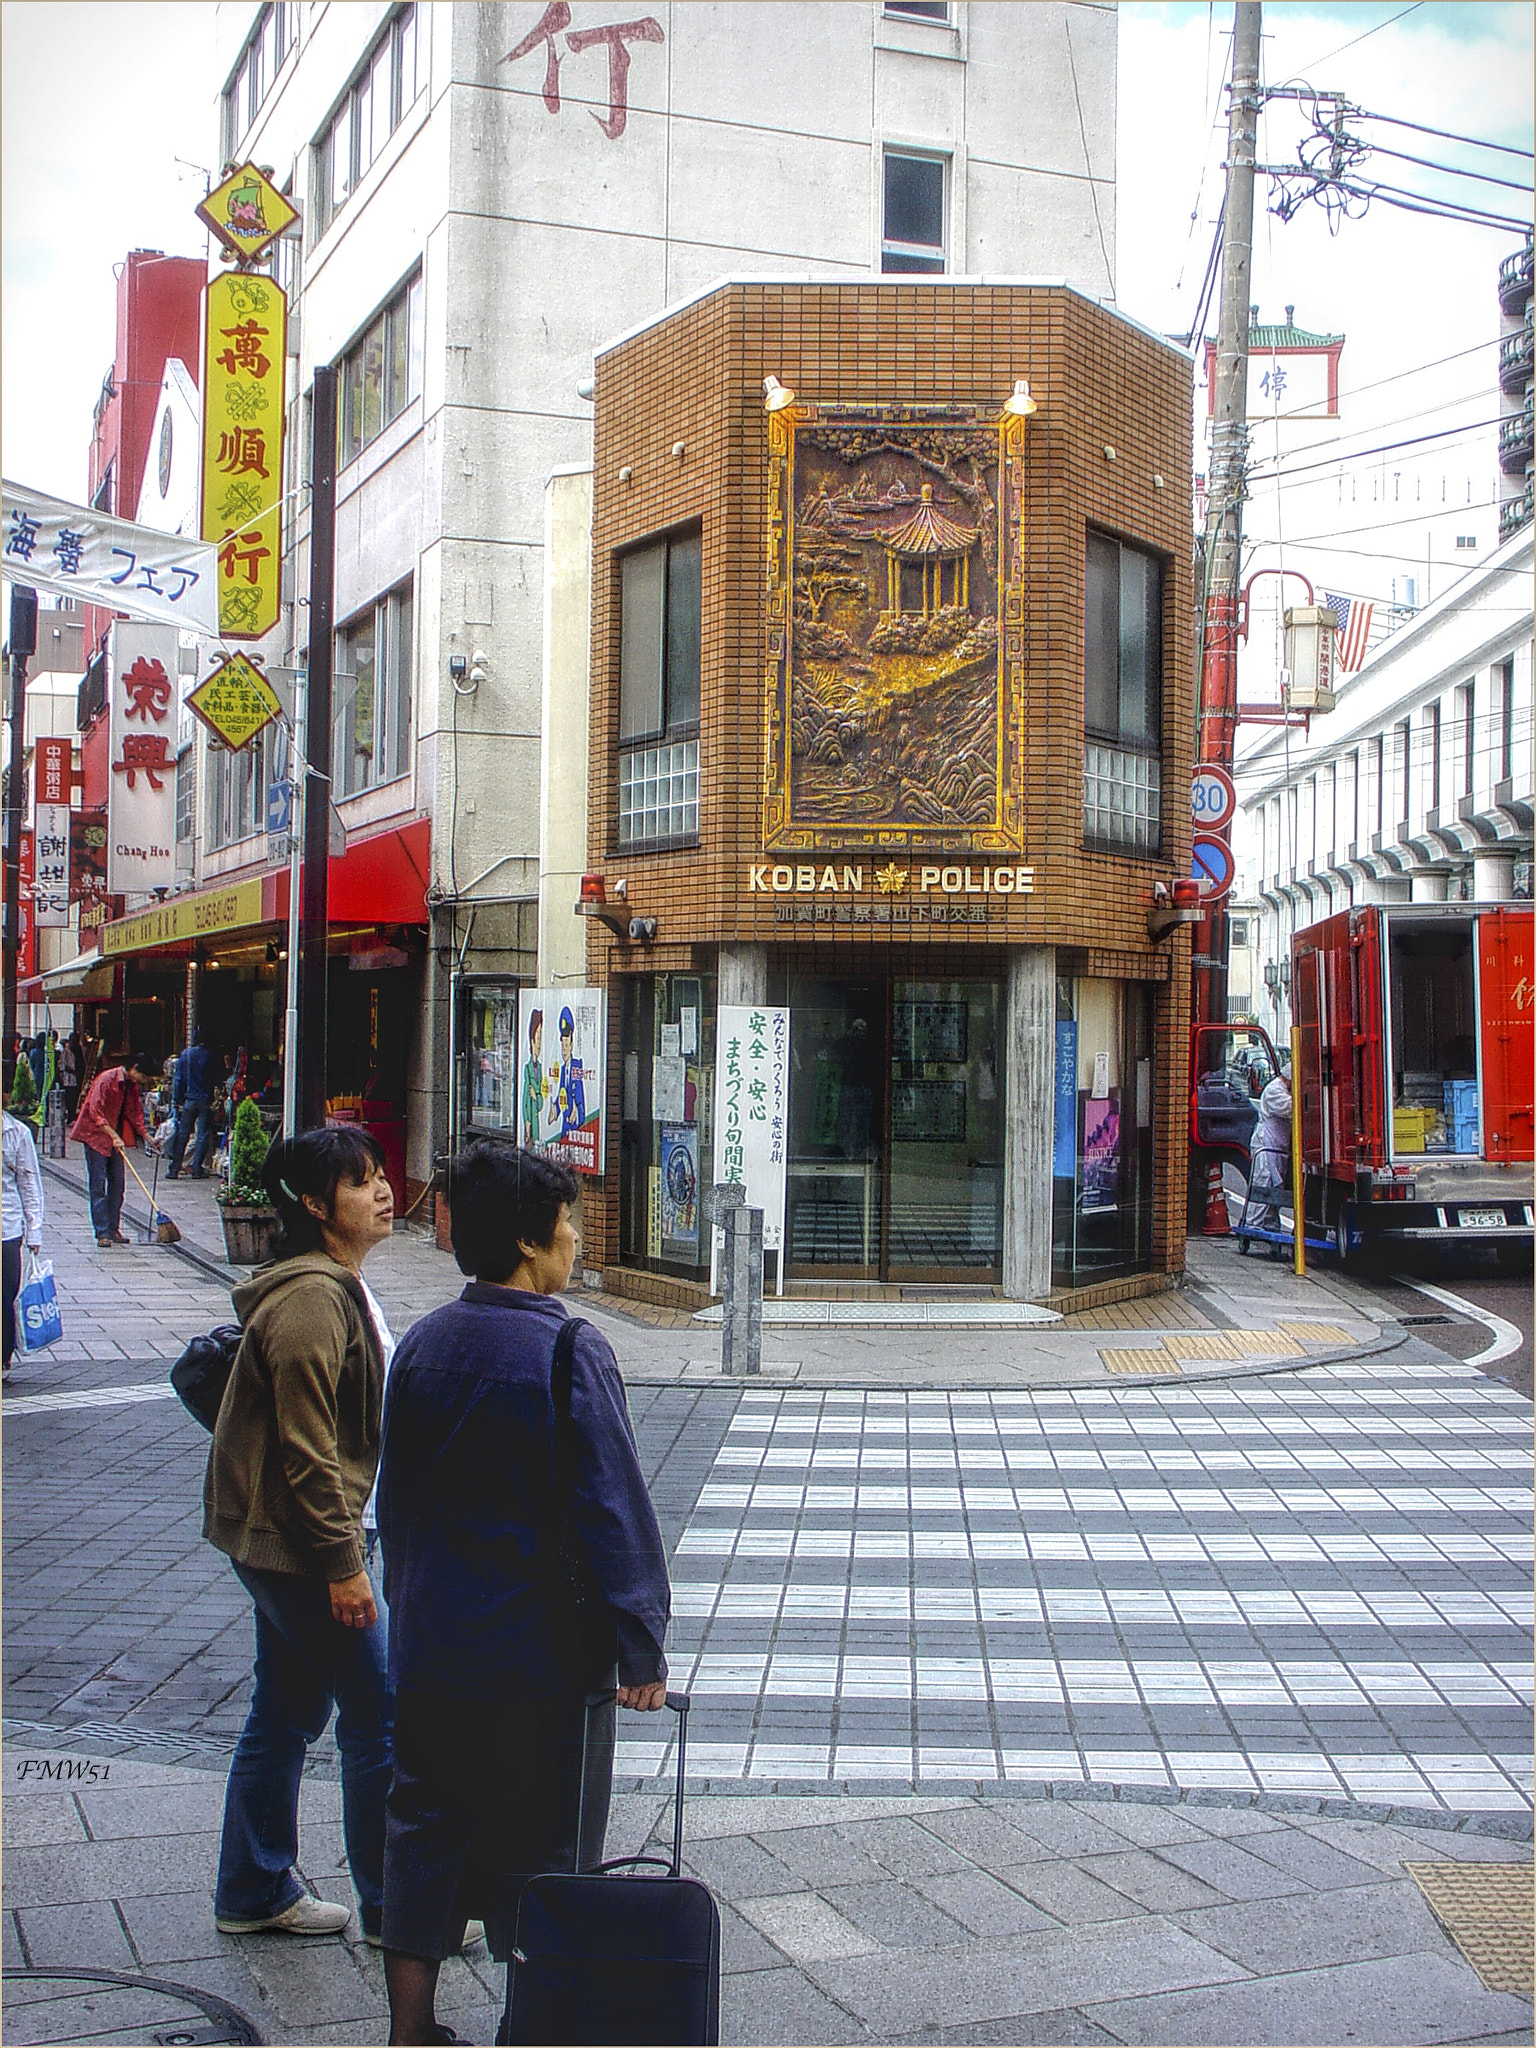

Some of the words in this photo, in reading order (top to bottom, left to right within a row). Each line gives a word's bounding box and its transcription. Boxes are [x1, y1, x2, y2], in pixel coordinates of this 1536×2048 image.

[1259, 365, 1287, 401] 停
[215, 318, 271, 585] 萬順行
[1192, 783, 1224, 813] 30
[750, 865, 863, 892] KOBAN
[921, 865, 1034, 893] POLICE
[776, 905, 989, 923] 加賀町警察署山下町交番
[1061, 1032, 1074, 1095] すこやかな
